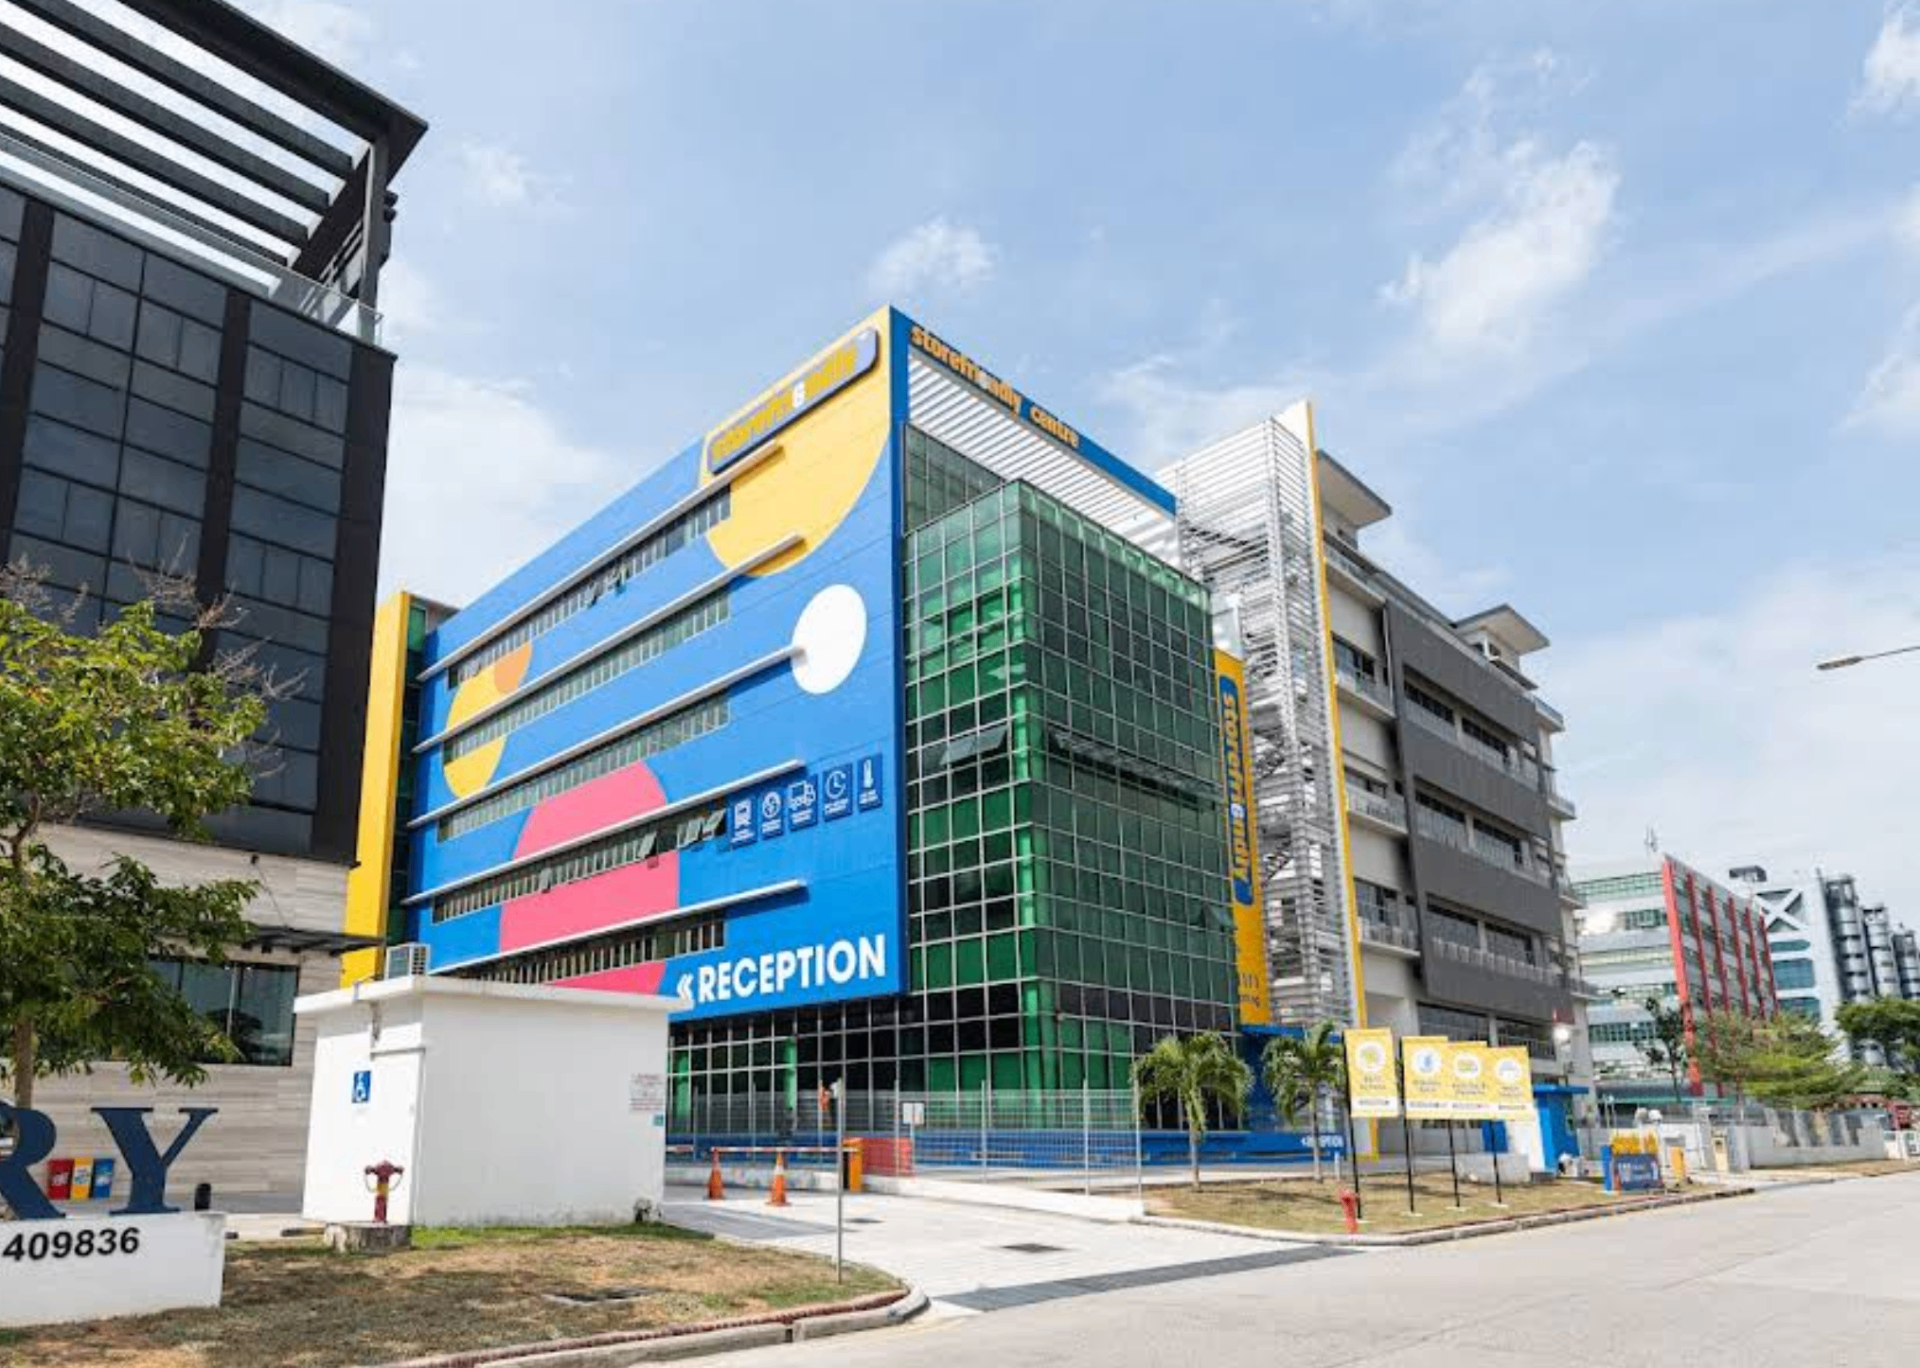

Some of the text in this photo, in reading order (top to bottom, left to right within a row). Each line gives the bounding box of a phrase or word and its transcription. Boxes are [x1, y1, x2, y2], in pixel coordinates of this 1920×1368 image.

[910, 324, 1079, 447] storefriendly centre
[697, 933, 886, 1004] RECEPTION
[2, 1226, 140, 1262] 409836
